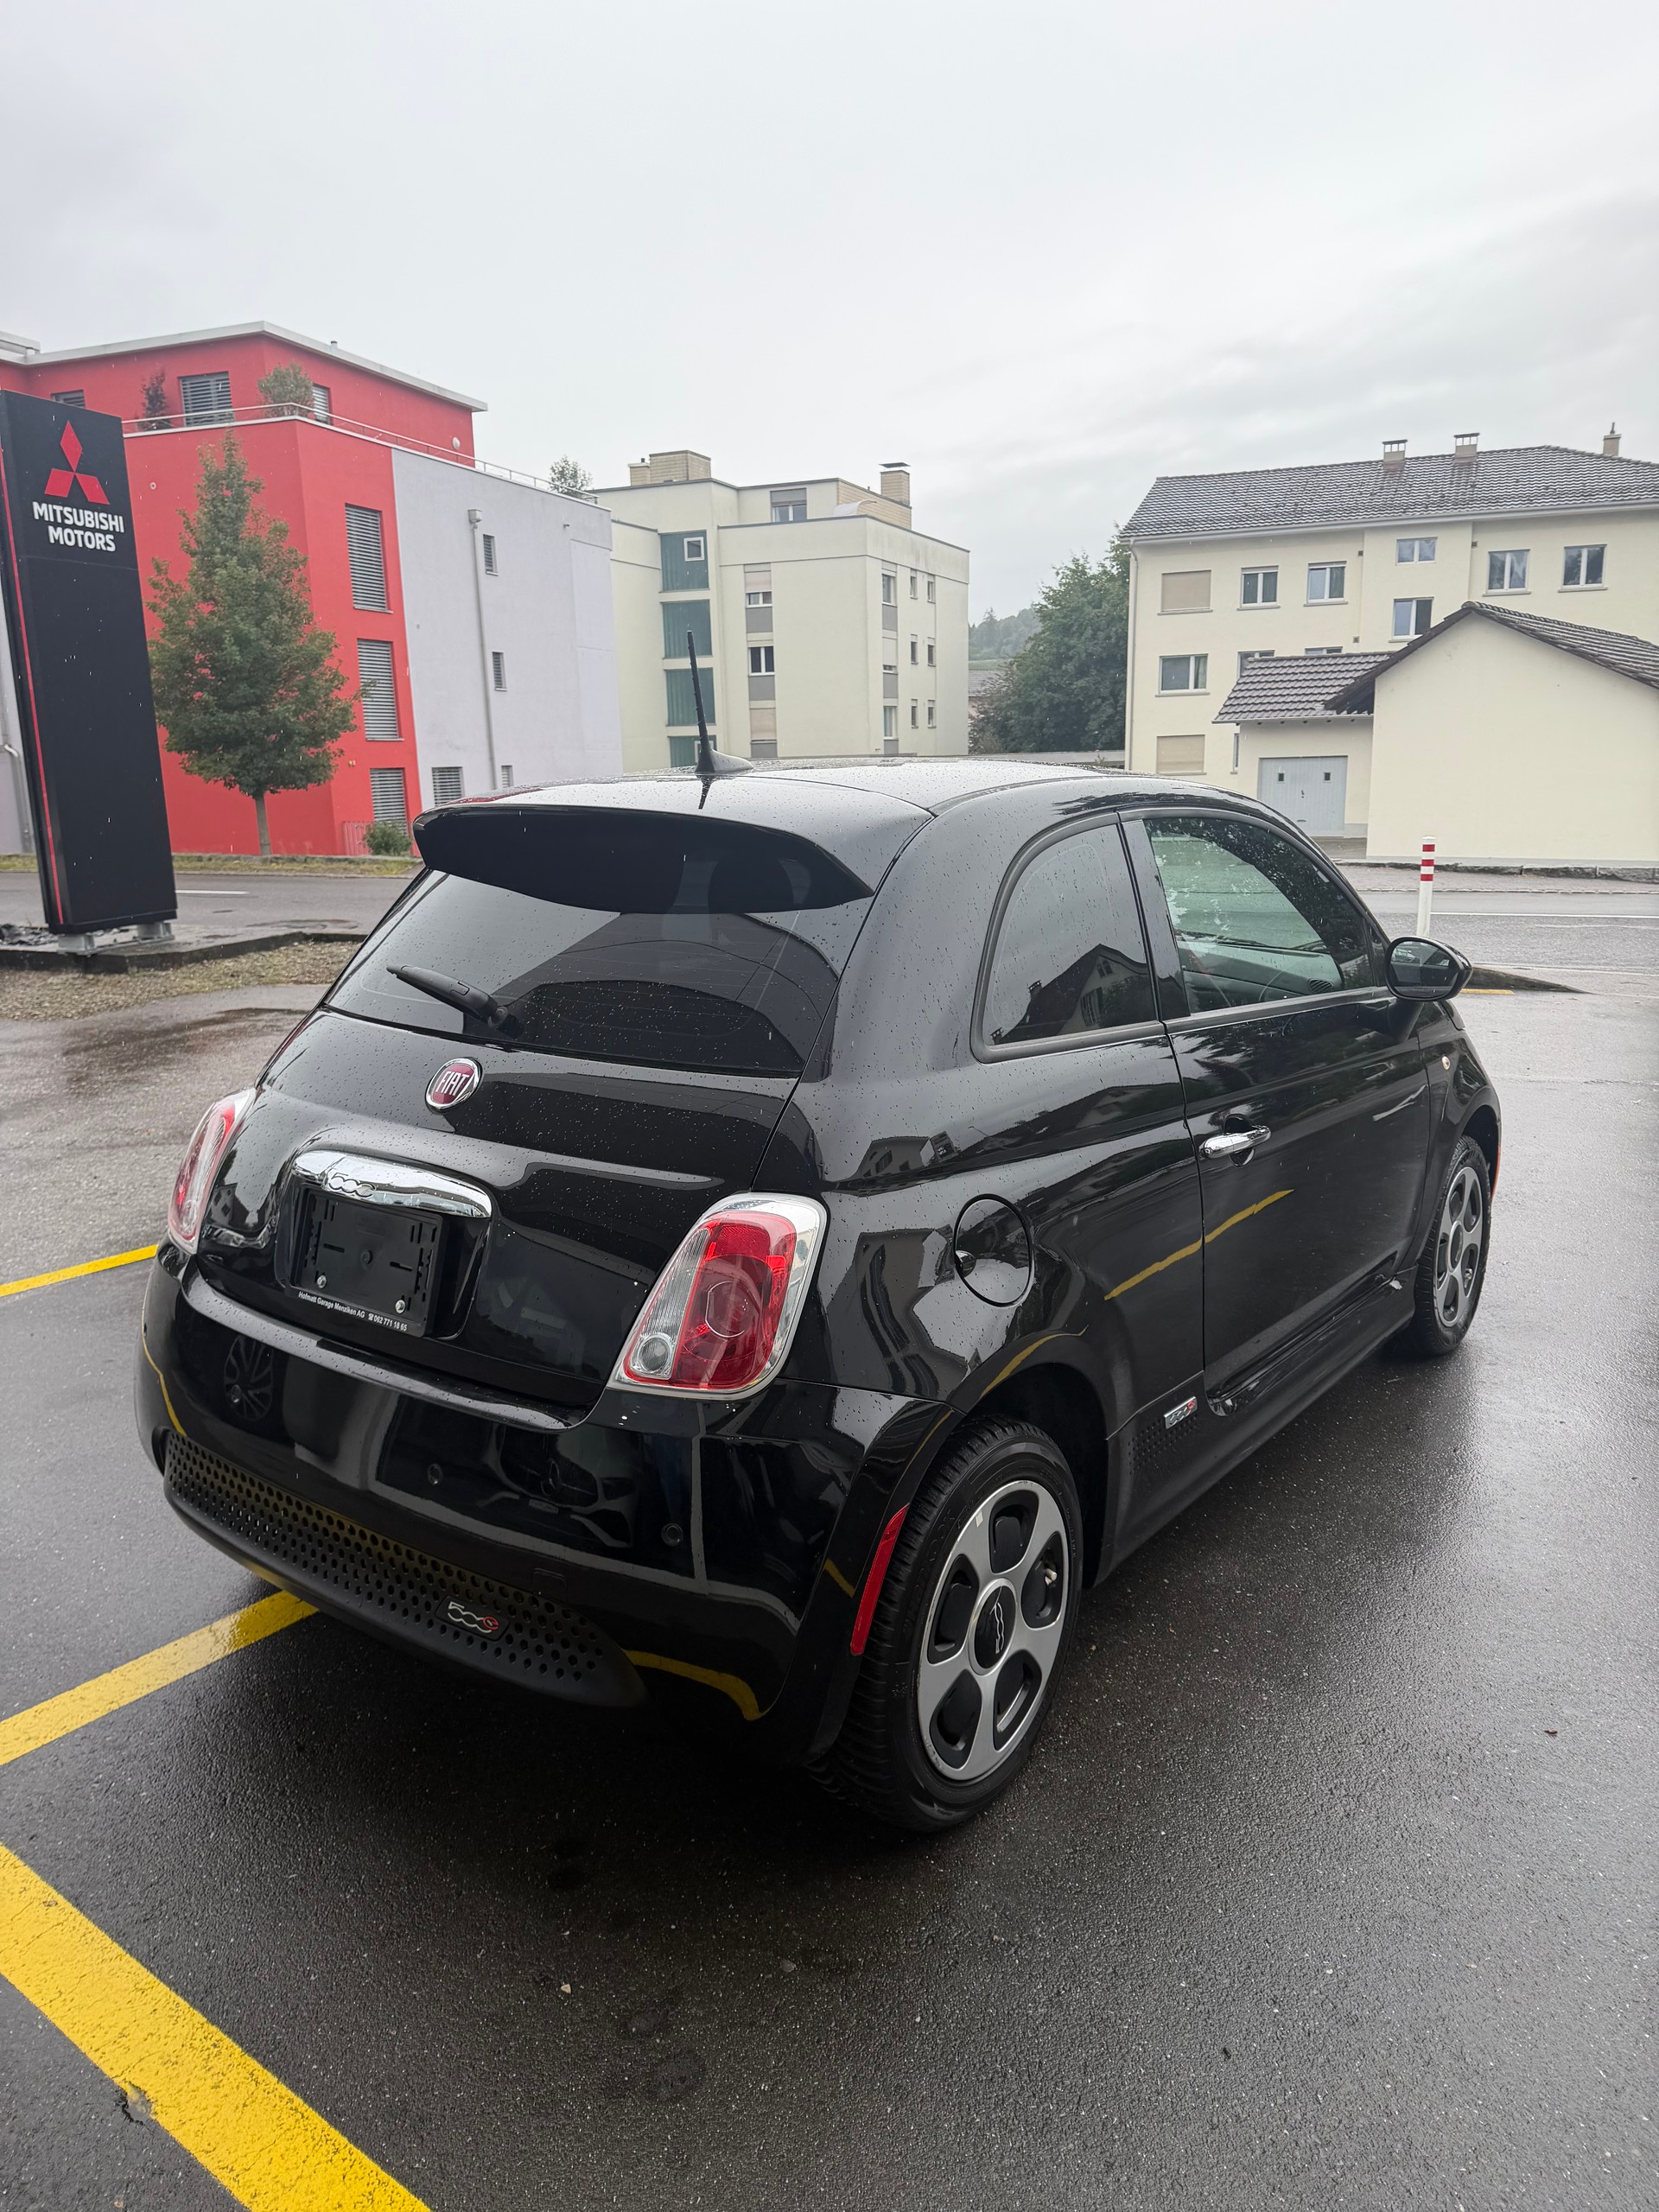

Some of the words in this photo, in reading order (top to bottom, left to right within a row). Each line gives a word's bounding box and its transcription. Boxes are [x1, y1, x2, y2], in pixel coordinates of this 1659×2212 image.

[32, 501, 125, 533] MITSUBISHI
[48, 525, 116, 552] MOTORS
[435, 1071, 470, 1096] FIAT
[328, 1172, 376, 1198] 500
[298, 1291, 317, 1303] Hofmatt
[316, 1297, 334, 1310] Garage
[334, 1302, 357, 1315] Menziken
[356, 1309, 365, 1319] AG
[373, 1314, 384, 1325] 062
[383, 1318, 393, 1327] 771
[393, 1320, 400, 1330] 18
[400, 1323, 408, 1332] 65
